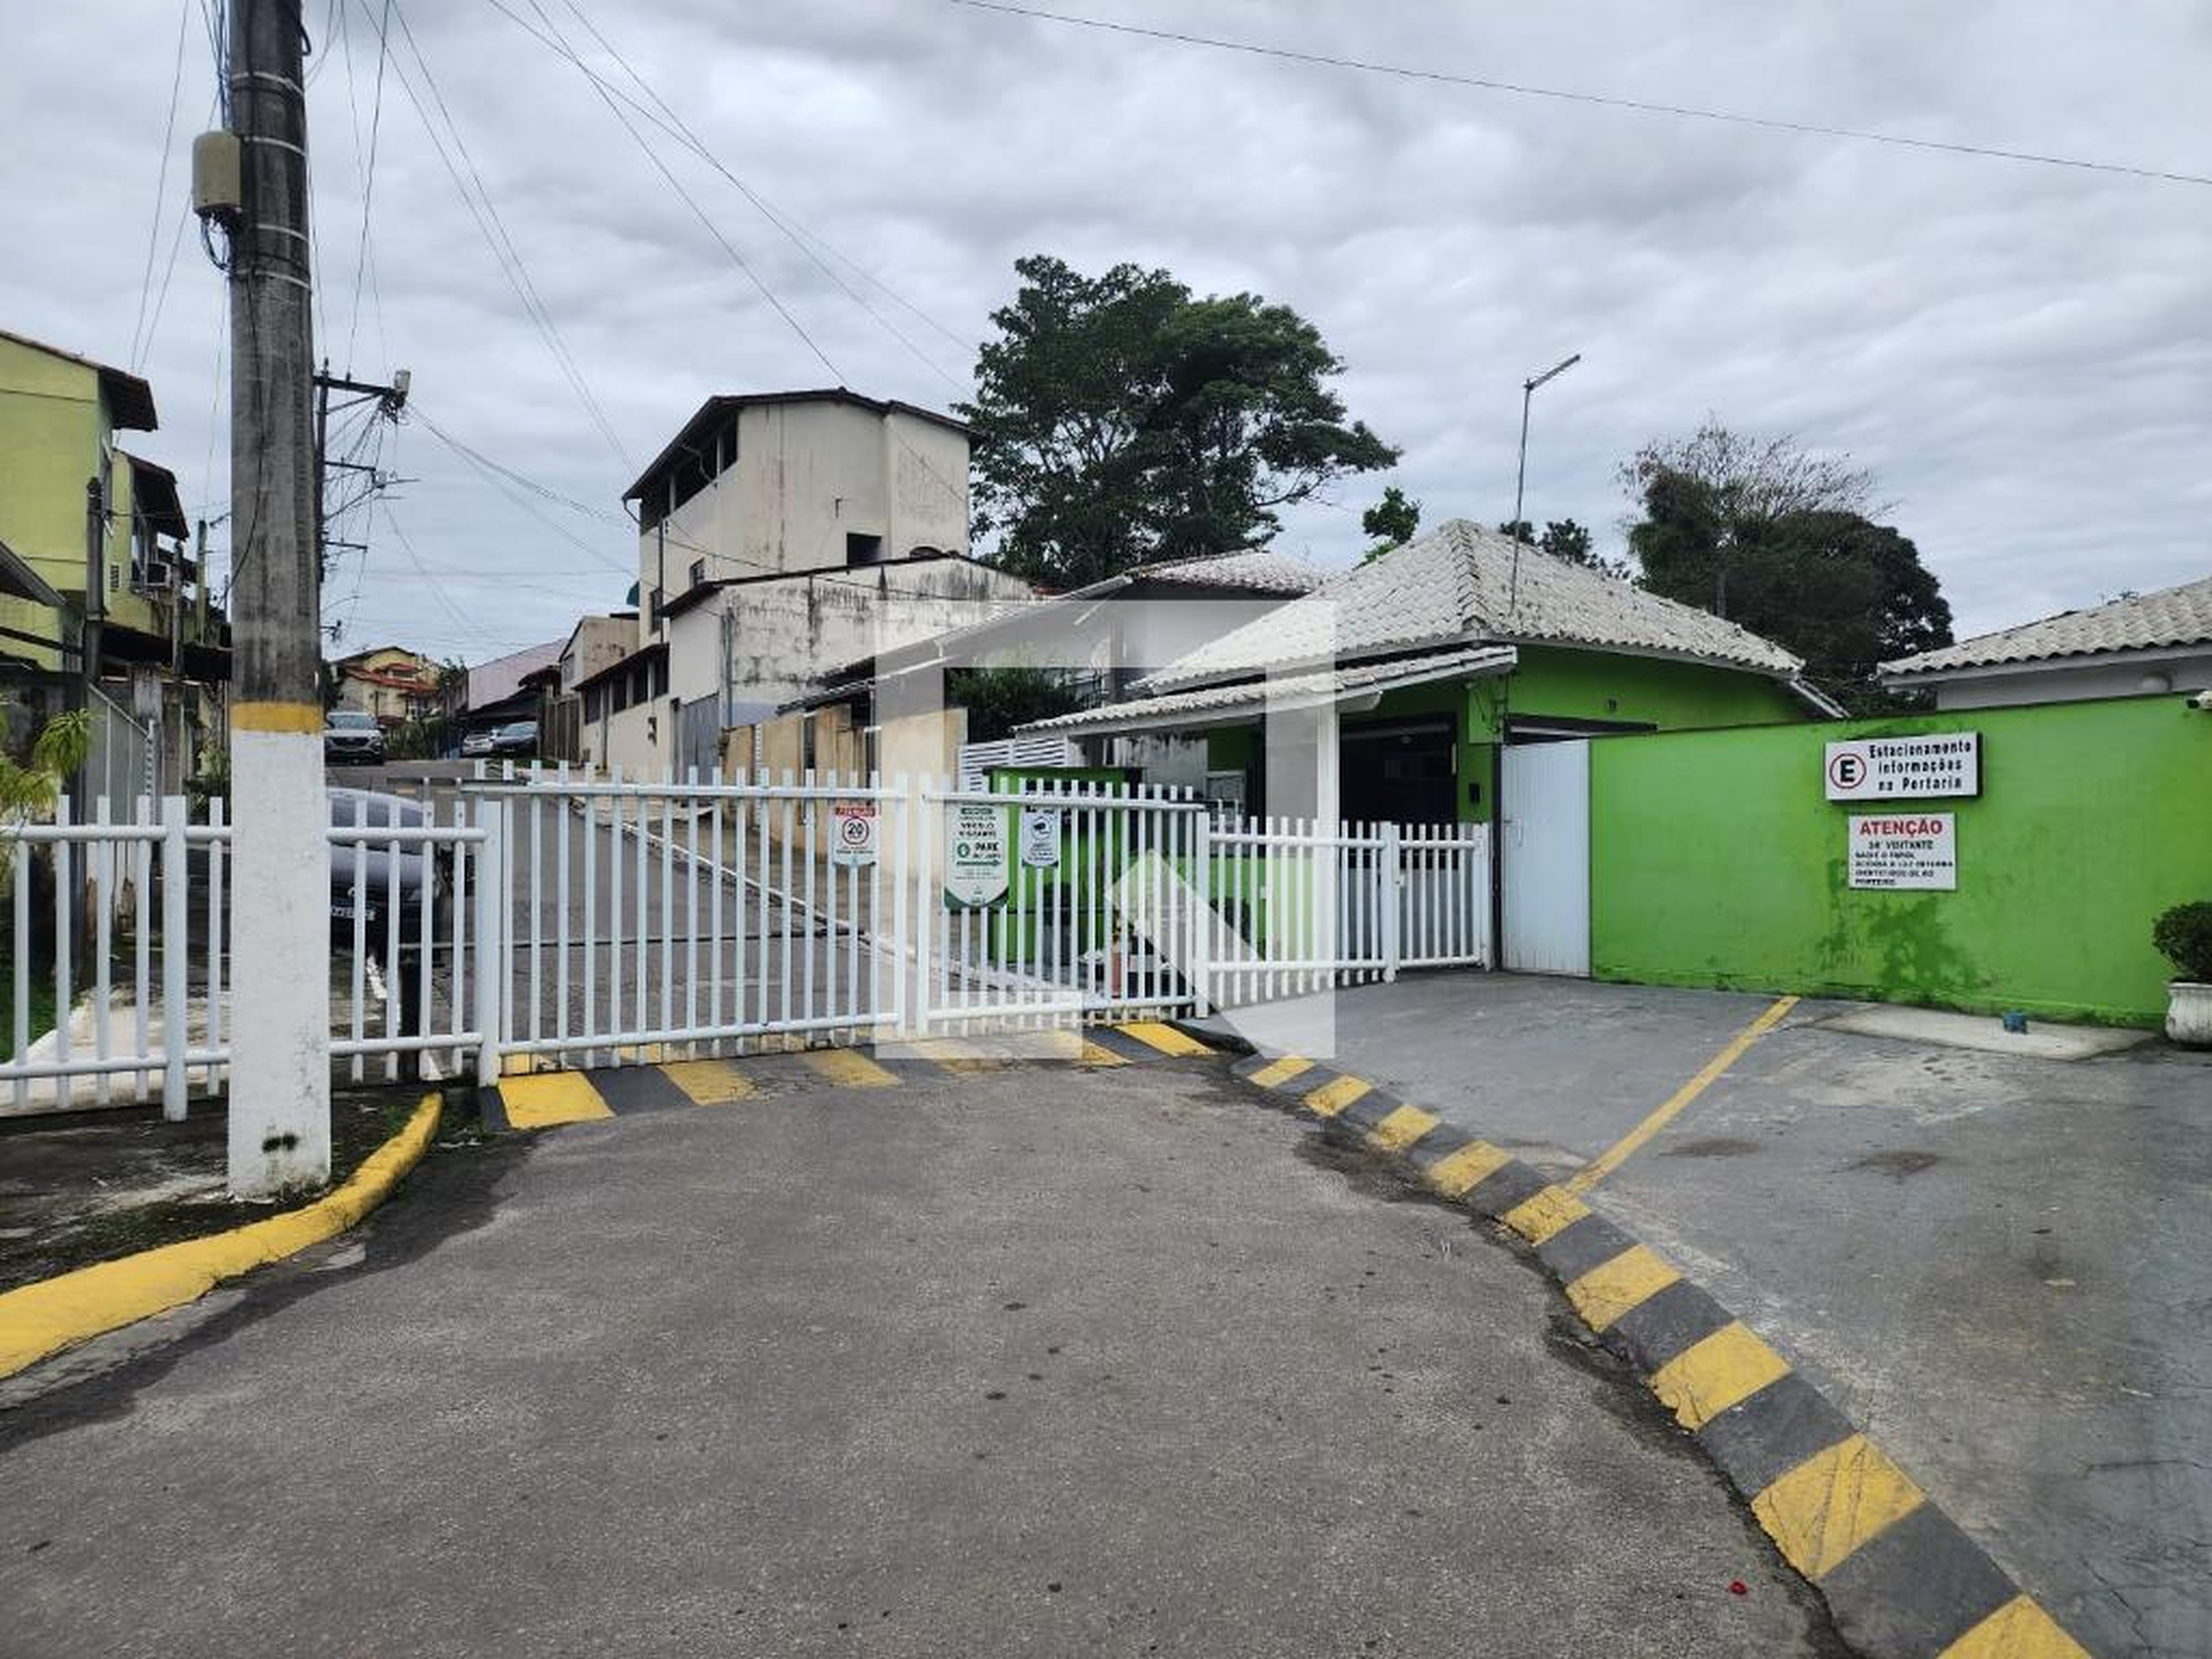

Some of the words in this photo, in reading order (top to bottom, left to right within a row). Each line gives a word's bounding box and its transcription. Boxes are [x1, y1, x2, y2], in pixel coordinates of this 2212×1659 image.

[1869, 740, 1971, 759] Estacionamento
[1840, 759, 1855, 783] E
[1859, 816, 1943, 837] ATENÇÃO
